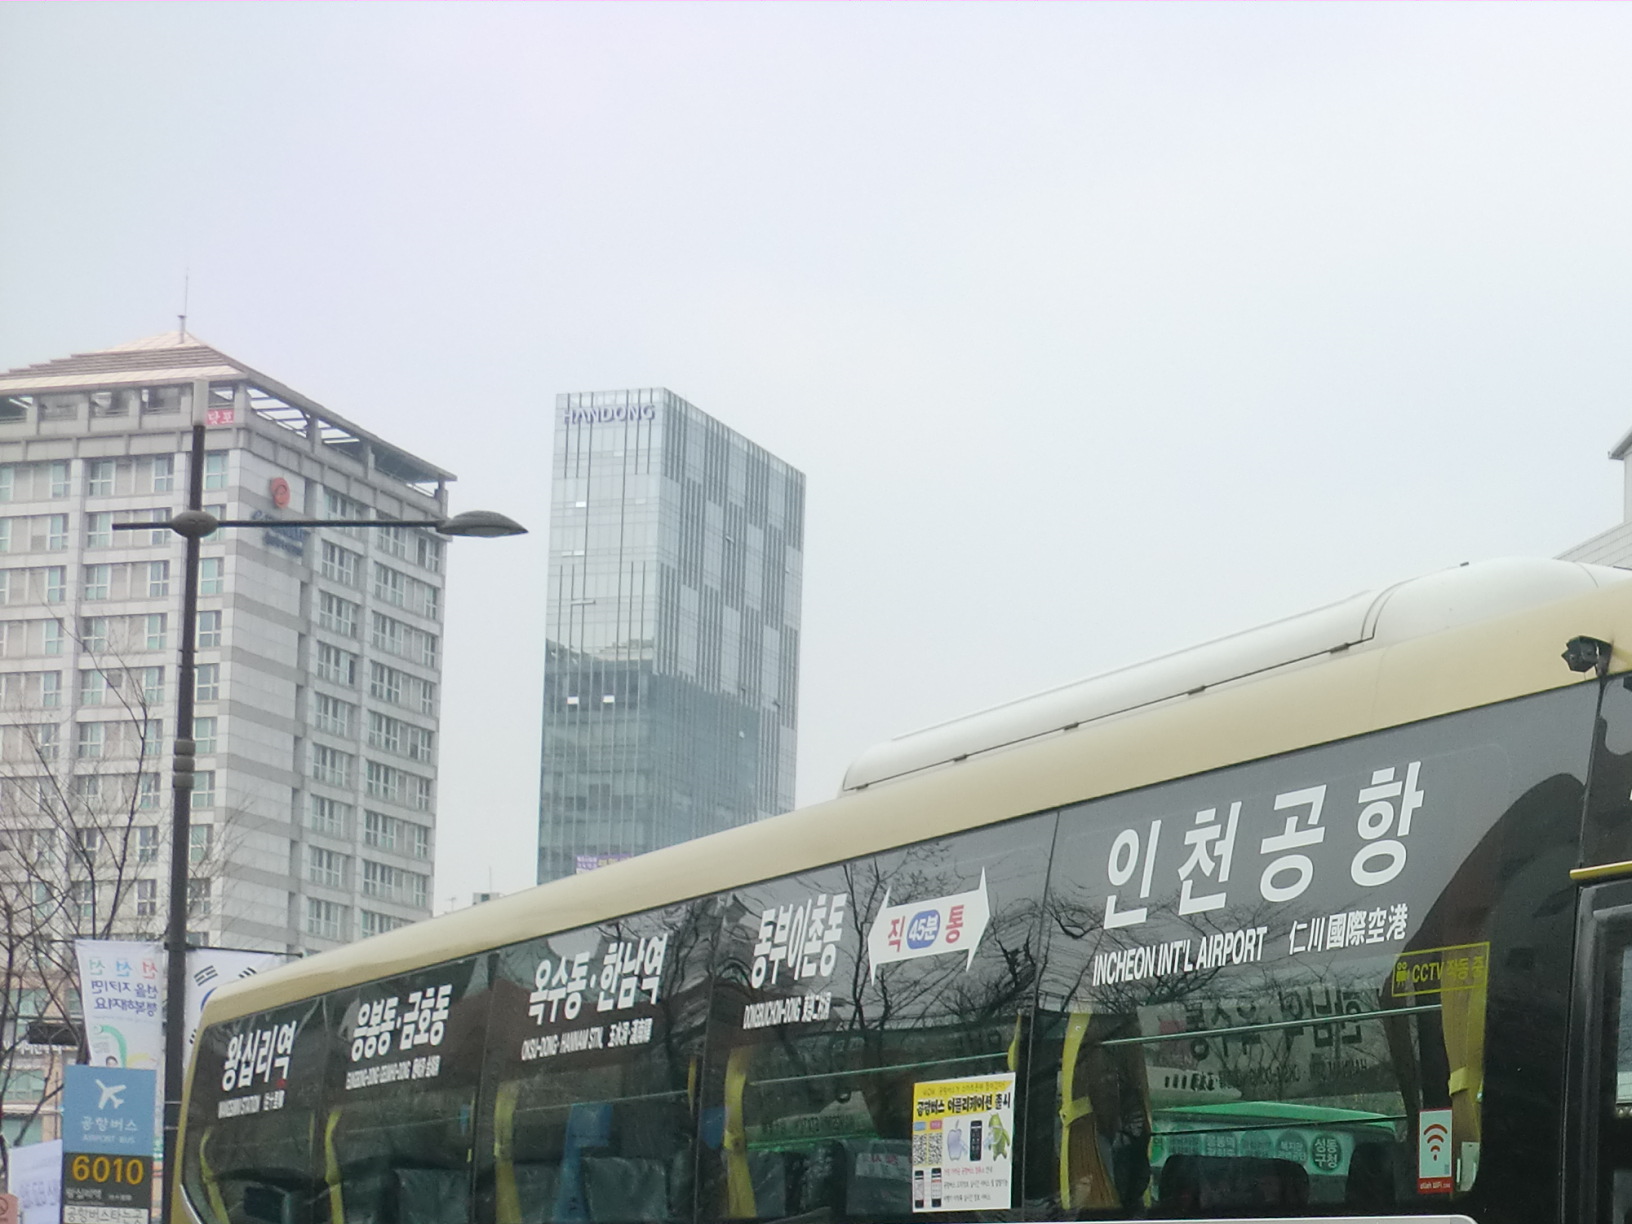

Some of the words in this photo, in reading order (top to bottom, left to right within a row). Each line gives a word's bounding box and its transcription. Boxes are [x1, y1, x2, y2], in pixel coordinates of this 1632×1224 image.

[564, 404, 656, 425] HANDONG
[1103, 761, 1425, 930] 인천공항
[751, 893, 848, 989] 동부이촌동
[888, 915, 906, 952] 직
[908, 914, 939, 943] 45분
[1289, 903, 1409, 955] 仁川國際空港
[1093, 944, 1156, 987] INCHEON
[1157, 937, 1194, 977] INT'L
[1195, 926, 1268, 971] AIRPORT
[1412, 961, 1445, 984] CCTV
[222, 1020, 298, 1092] 왕십리역
[81, 1116, 139, 1132] 공항버스
[72, 1155, 144, 1185] 6010
